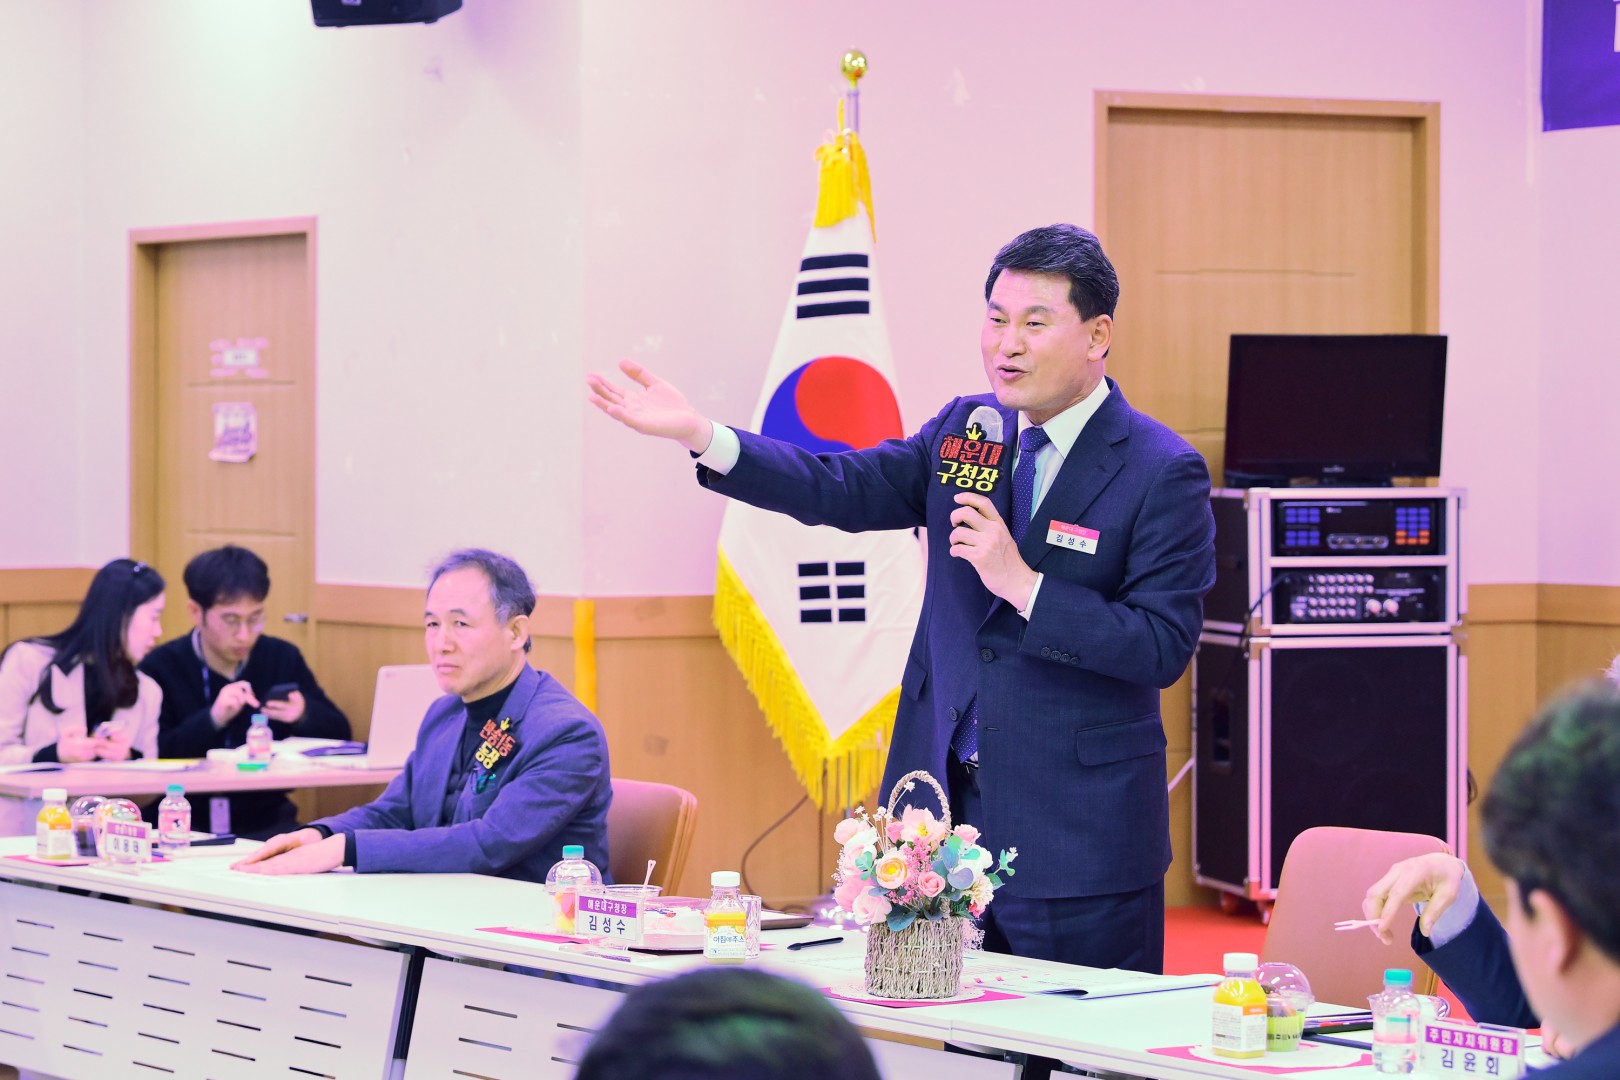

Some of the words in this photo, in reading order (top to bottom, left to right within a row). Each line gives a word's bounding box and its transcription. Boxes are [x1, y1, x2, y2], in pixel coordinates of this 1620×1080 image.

[940, 435, 1003, 466] 해운대
[937, 460, 998, 492] 구청장
[475, 741, 501, 770] 동장
